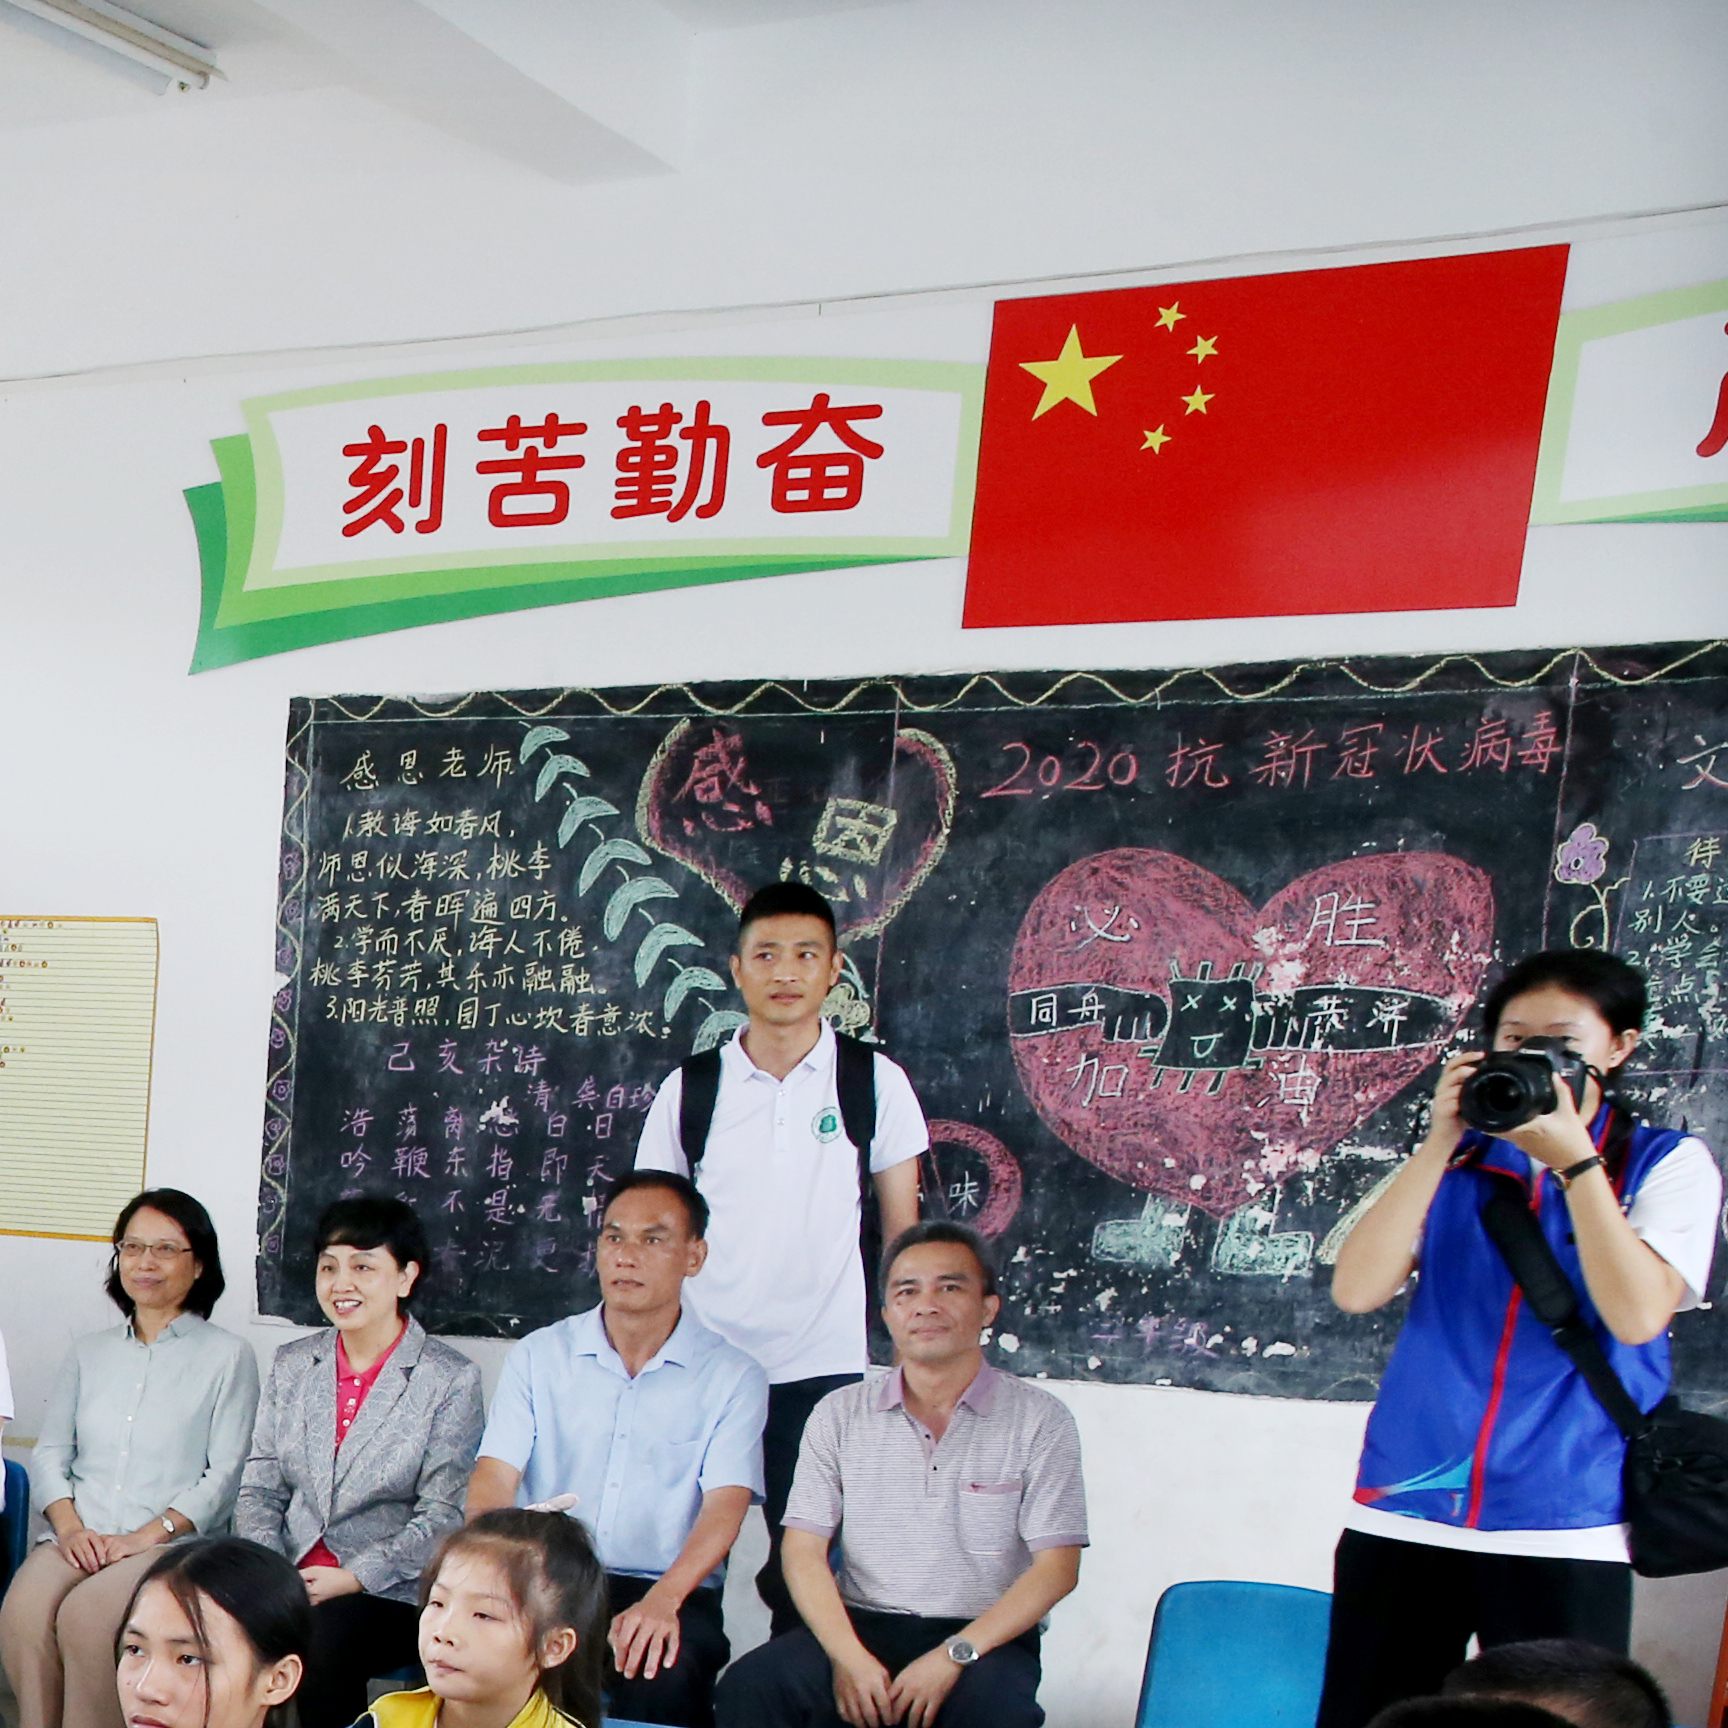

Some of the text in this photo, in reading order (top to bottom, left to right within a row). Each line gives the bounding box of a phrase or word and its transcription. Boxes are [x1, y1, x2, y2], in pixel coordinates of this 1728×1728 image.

[342, 391, 885, 539] 刻苦勤奋
[340, 744, 514, 792] 感恩老师
